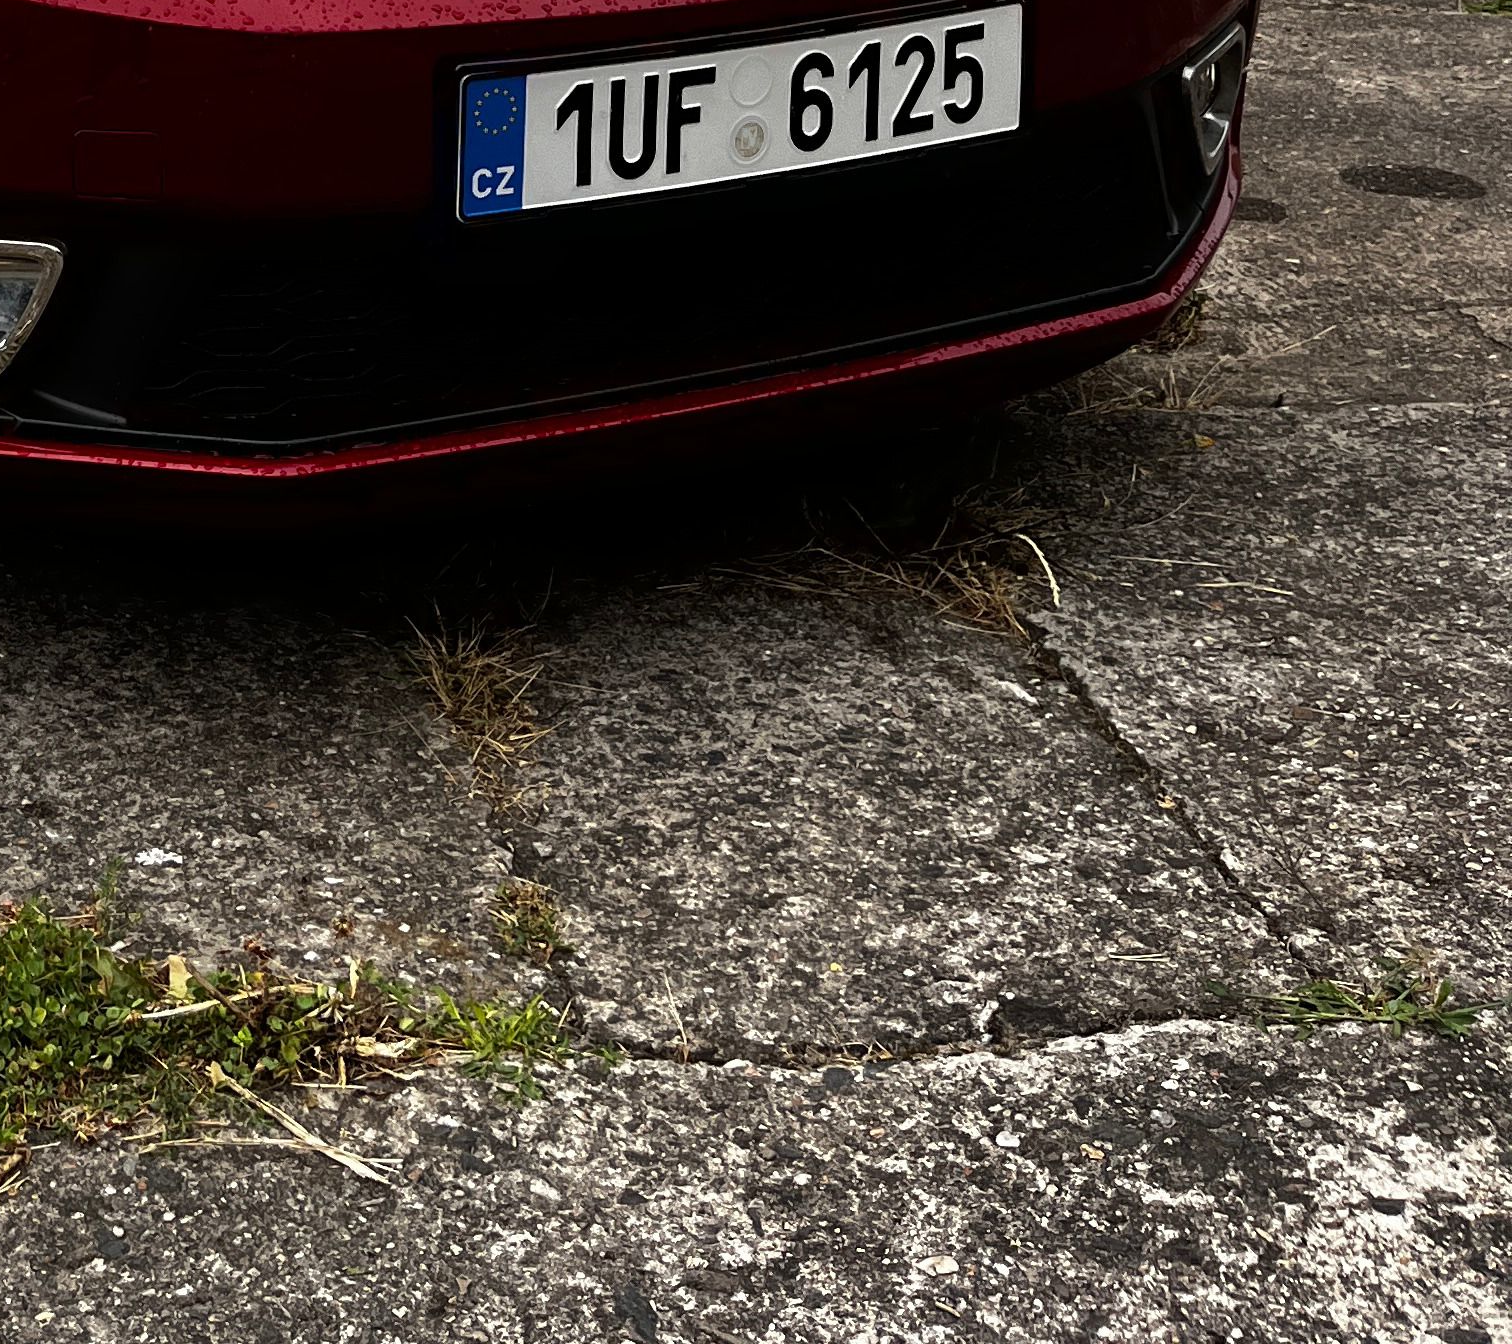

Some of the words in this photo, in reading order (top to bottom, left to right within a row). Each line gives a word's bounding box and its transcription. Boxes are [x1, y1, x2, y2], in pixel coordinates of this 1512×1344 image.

[555, 66, 717, 187] 1UF
[789, 22, 985, 153] 6125
[471, 165, 515, 199] CZ
